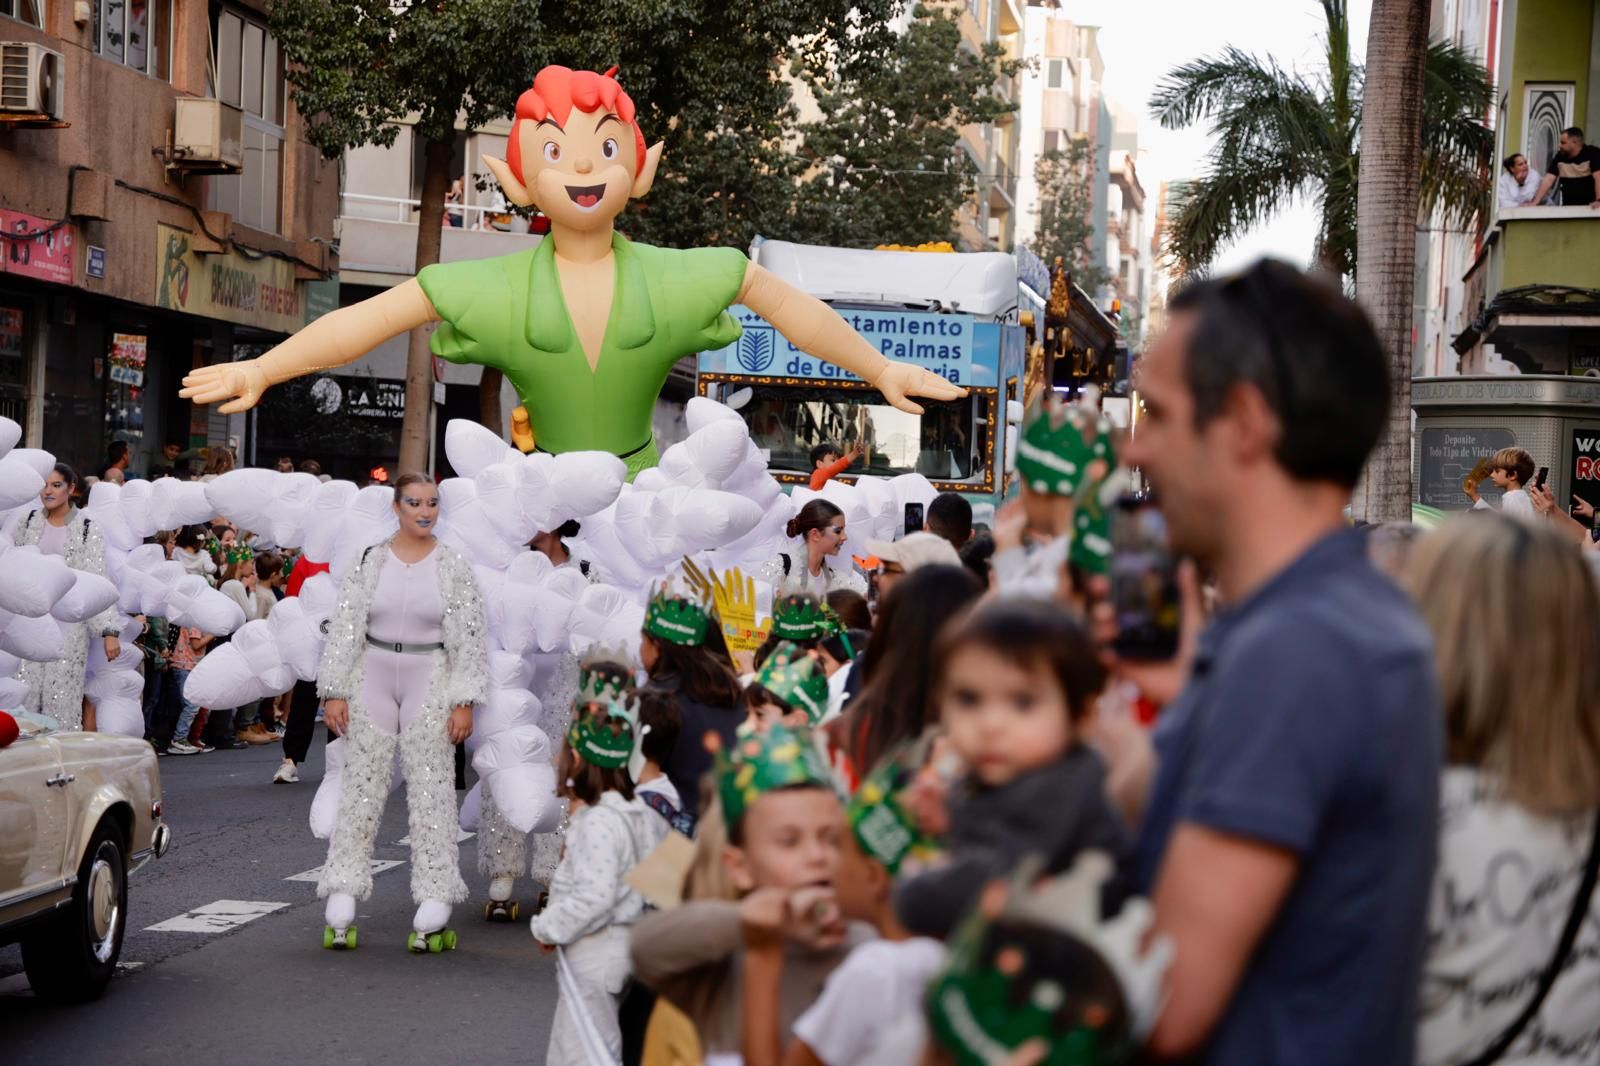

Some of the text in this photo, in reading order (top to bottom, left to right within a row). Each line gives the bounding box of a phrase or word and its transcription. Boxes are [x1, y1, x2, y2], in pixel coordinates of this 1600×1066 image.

[843, 315, 963, 336] tamiento
[881, 339, 962, 359] Palmas
[786, 356, 813, 376] de
[348, 389, 405, 408] LA UNI
[1466, 384, 1484, 399] DE
[1486, 384, 1545, 399] VIDRIO
[1444, 434, 1476, 447] Deposite
[1443, 447, 1459, 460] Tipo
[1460, 446, 1470, 457] de
